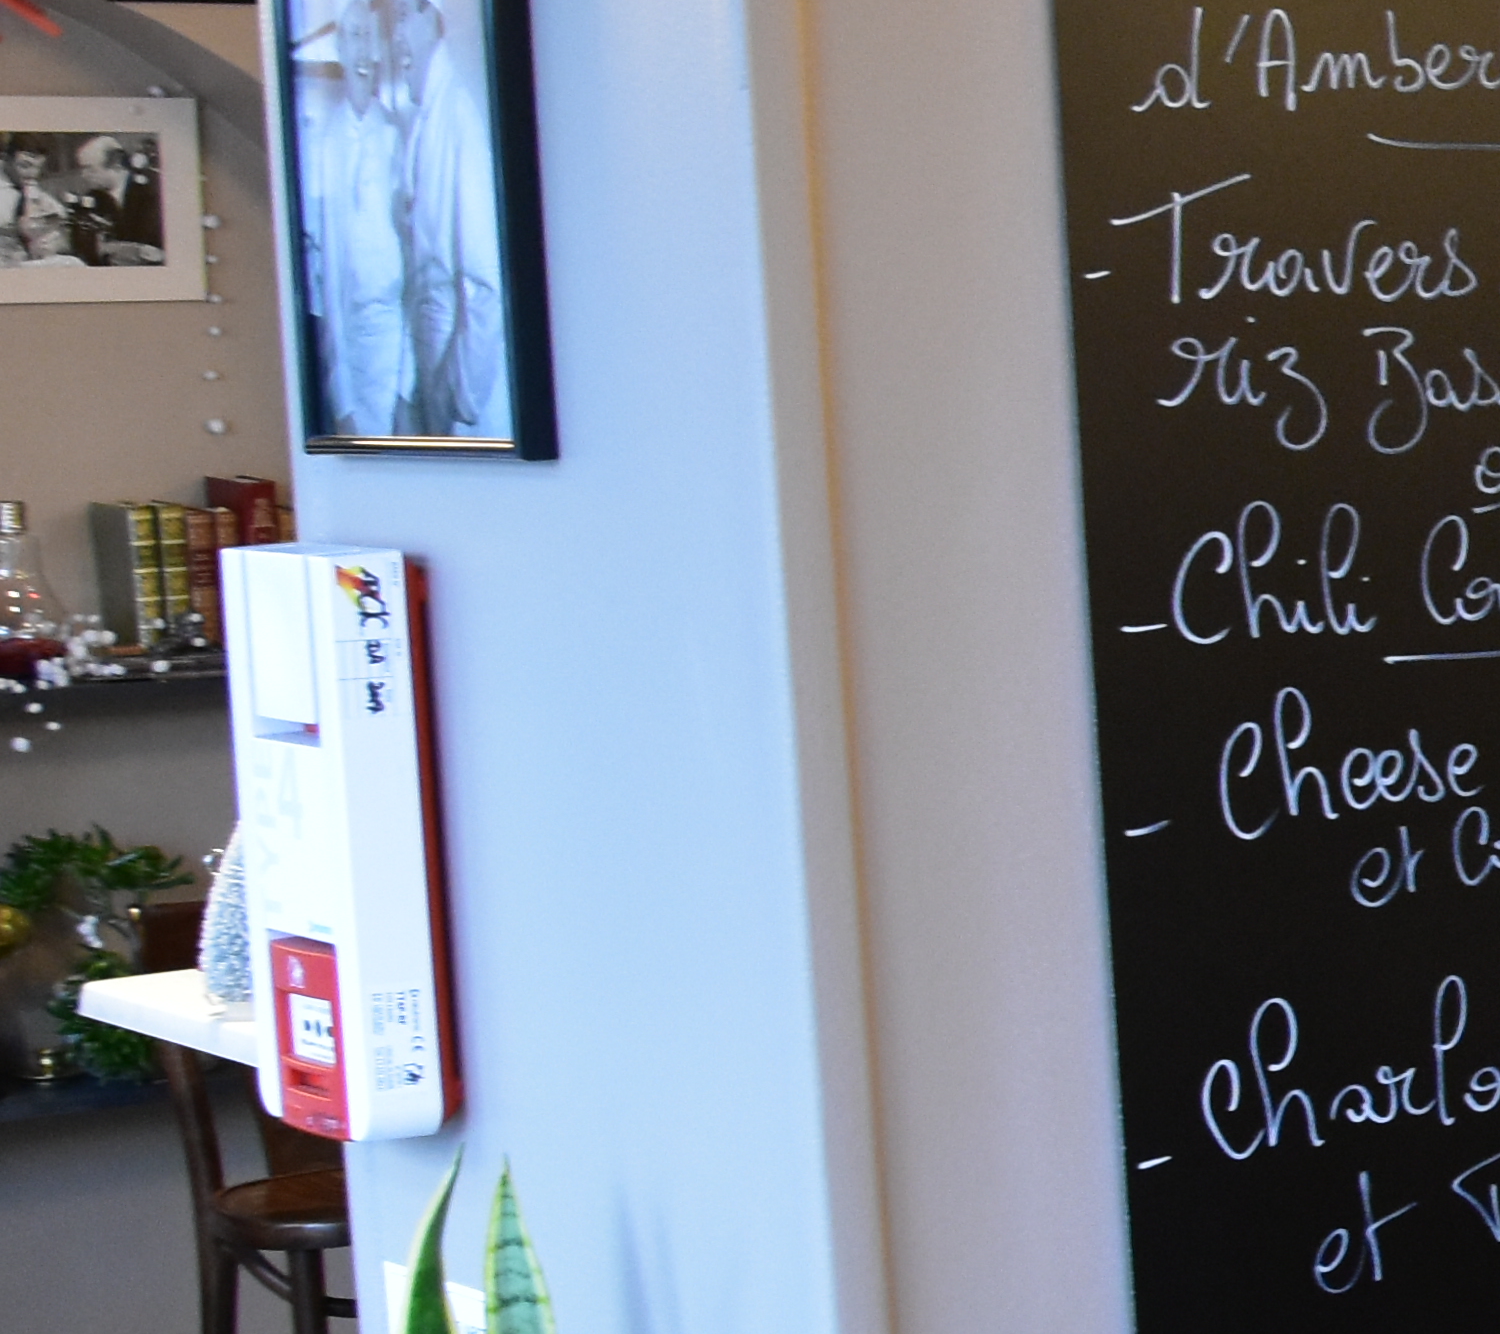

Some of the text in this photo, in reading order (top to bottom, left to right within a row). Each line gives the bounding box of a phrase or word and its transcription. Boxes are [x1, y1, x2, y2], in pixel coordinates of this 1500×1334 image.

[1110, 173, 1479, 304] Travers
[1155, 315, 1329, 451] riz
[1170, 500, 1378, 647] Chili
[1218, 685, 1485, 841] Cheese
[1350, 821, 1422, 907] et
[1313, 1171, 1419, 1294] et
